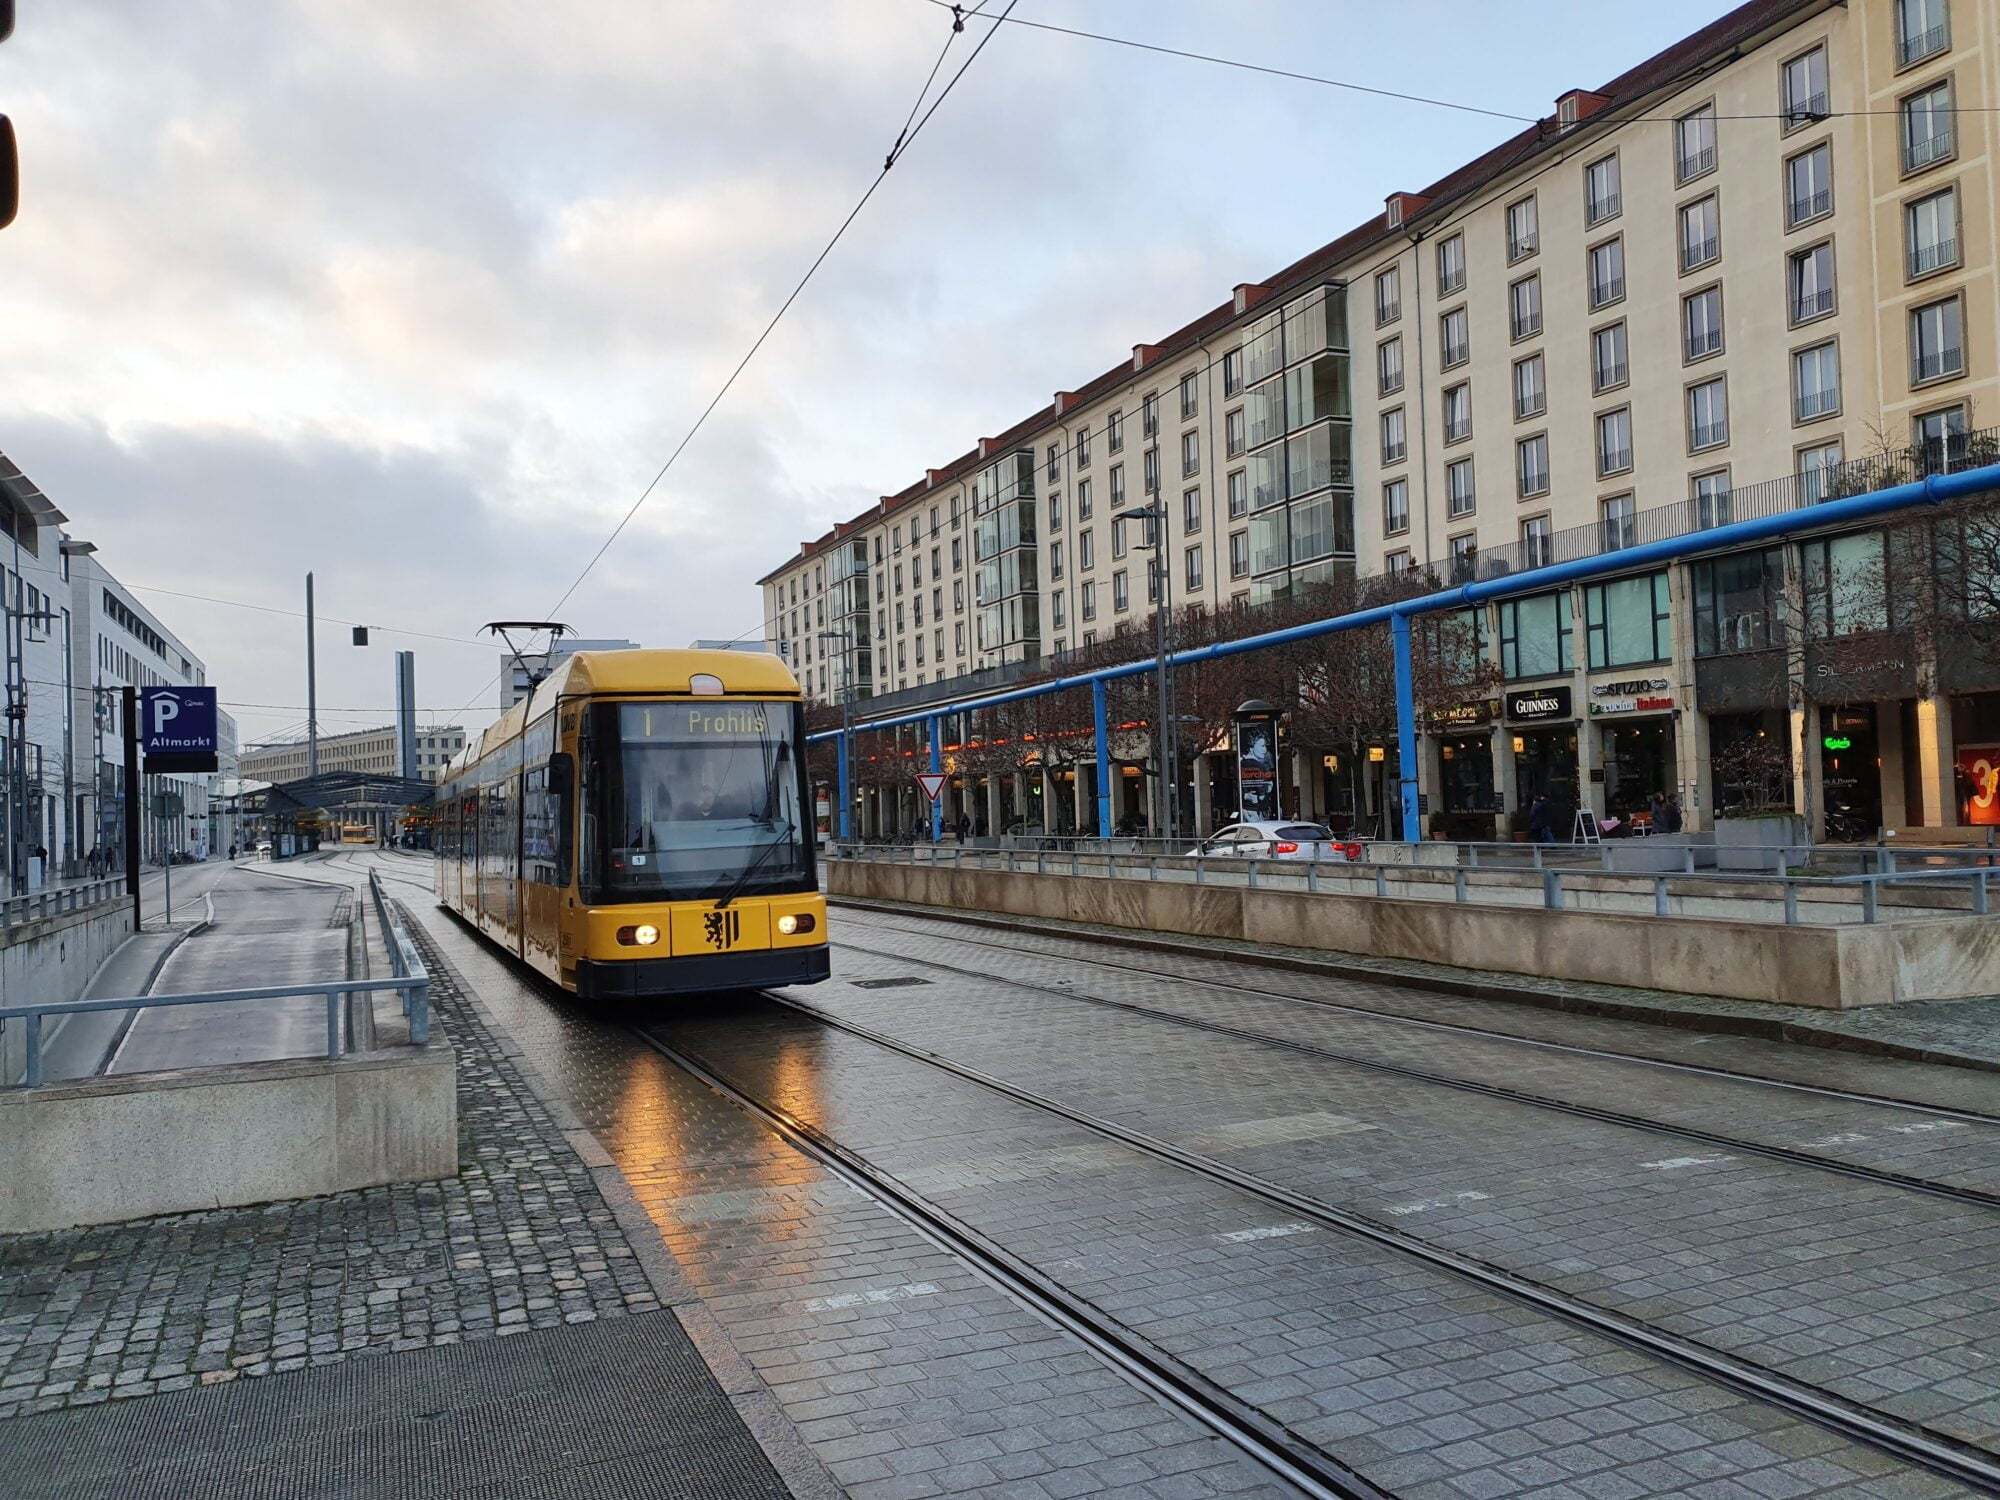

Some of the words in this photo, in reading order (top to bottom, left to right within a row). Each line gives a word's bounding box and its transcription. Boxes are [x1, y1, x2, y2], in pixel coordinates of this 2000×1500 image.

[780, 642, 788, 654] E
[1515, 698, 1559, 714] GUINNESS
[154, 699, 179, 733] P
[643, 709, 651, 737] 1
[688, 709, 766, 734] Prohlis
[150, 737, 211, 747] Altmarkt
